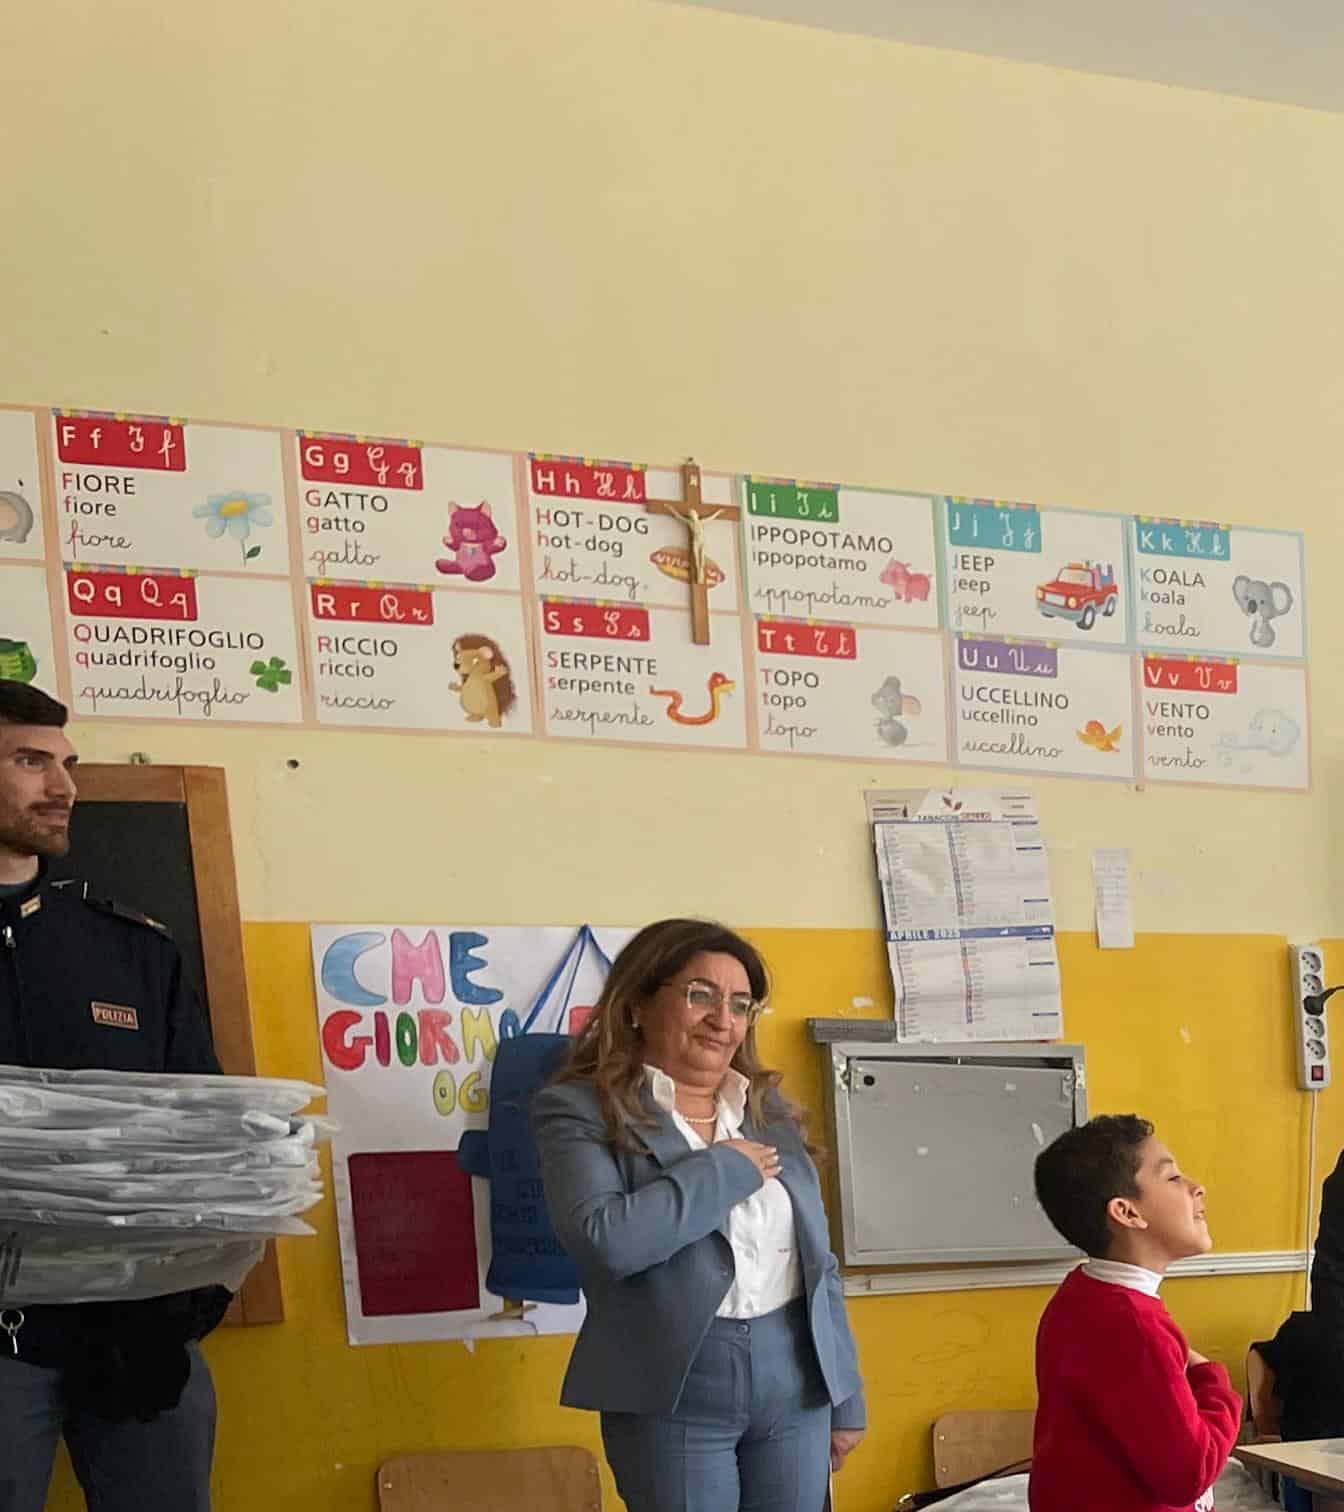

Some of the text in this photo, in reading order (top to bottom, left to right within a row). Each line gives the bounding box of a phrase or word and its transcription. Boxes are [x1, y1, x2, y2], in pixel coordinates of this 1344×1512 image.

[62, 427, 76, 446] F
[91, 429, 102, 448] f
[305, 447, 323, 466] G
[333, 452, 350, 473] g
[62, 473, 136, 495] FIORE
[537, 472, 555, 492] H
[566, 474, 579, 494] h
[64, 497, 117, 517] fiore
[305, 490, 388, 513] GATTO
[751, 490, 776, 513] I i
[306, 515, 365, 534] gatto
[535, 509, 649, 535] HOT-DOG
[66, 521, 132, 559] fiore
[537, 532, 624, 557] hot-dog
[751, 525, 893, 553] IPPOPOTAMO
[1142, 534, 1154, 550] K
[1161, 535, 1174, 551] k
[307, 541, 381, 577] gatto
[752, 551, 866, 573] ippopotamo
[952, 555, 994, 572] JEEP
[953, 575, 991, 594] jeep
[1140, 569, 1205, 588] KOALA
[74, 578, 187, 617] Q q Q q
[318, 594, 335, 614] R
[350, 601, 360, 617] r
[380, 596, 406, 620] R
[754, 581, 891, 614] ippopotamo
[1140, 588, 1185, 606] koala
[548, 612, 560, 631] S
[573, 615, 584, 631] s
[952, 602, 998, 630] jeep
[1142, 612, 1200, 637] koala
[74, 624, 264, 650] QUADRIFOGLIO
[318, 637, 397, 657] RICCIO
[760, 630, 776, 649] T
[784, 634, 796, 650] t
[76, 650, 215, 673] quadrifoglio
[319, 660, 374, 679] riccio
[547, 651, 657, 675] SERPENTE
[963, 649, 978, 668] U
[985, 654, 999, 670] u
[548, 673, 635, 696] serpente
[761, 668, 819, 688] TOPO
[1147, 667, 1162, 685] V
[1168, 672, 1179, 685] v
[78, 679, 250, 715] quadrifoglio
[320, 693, 395, 711] riccio
[763, 692, 807, 710] topo
[961, 685, 1069, 710] UCCELLINO
[550, 703, 654, 736] serpente
[962, 708, 1038, 727] uccellino
[1147, 702, 1210, 720] VENTO
[763, 714, 817, 747] topo
[1148, 723, 1194, 738] vento
[962, 733, 1063, 758] uccellino
[1148, 751, 1206, 769] vento
[96, 1007, 134, 1025] POLIZIA
